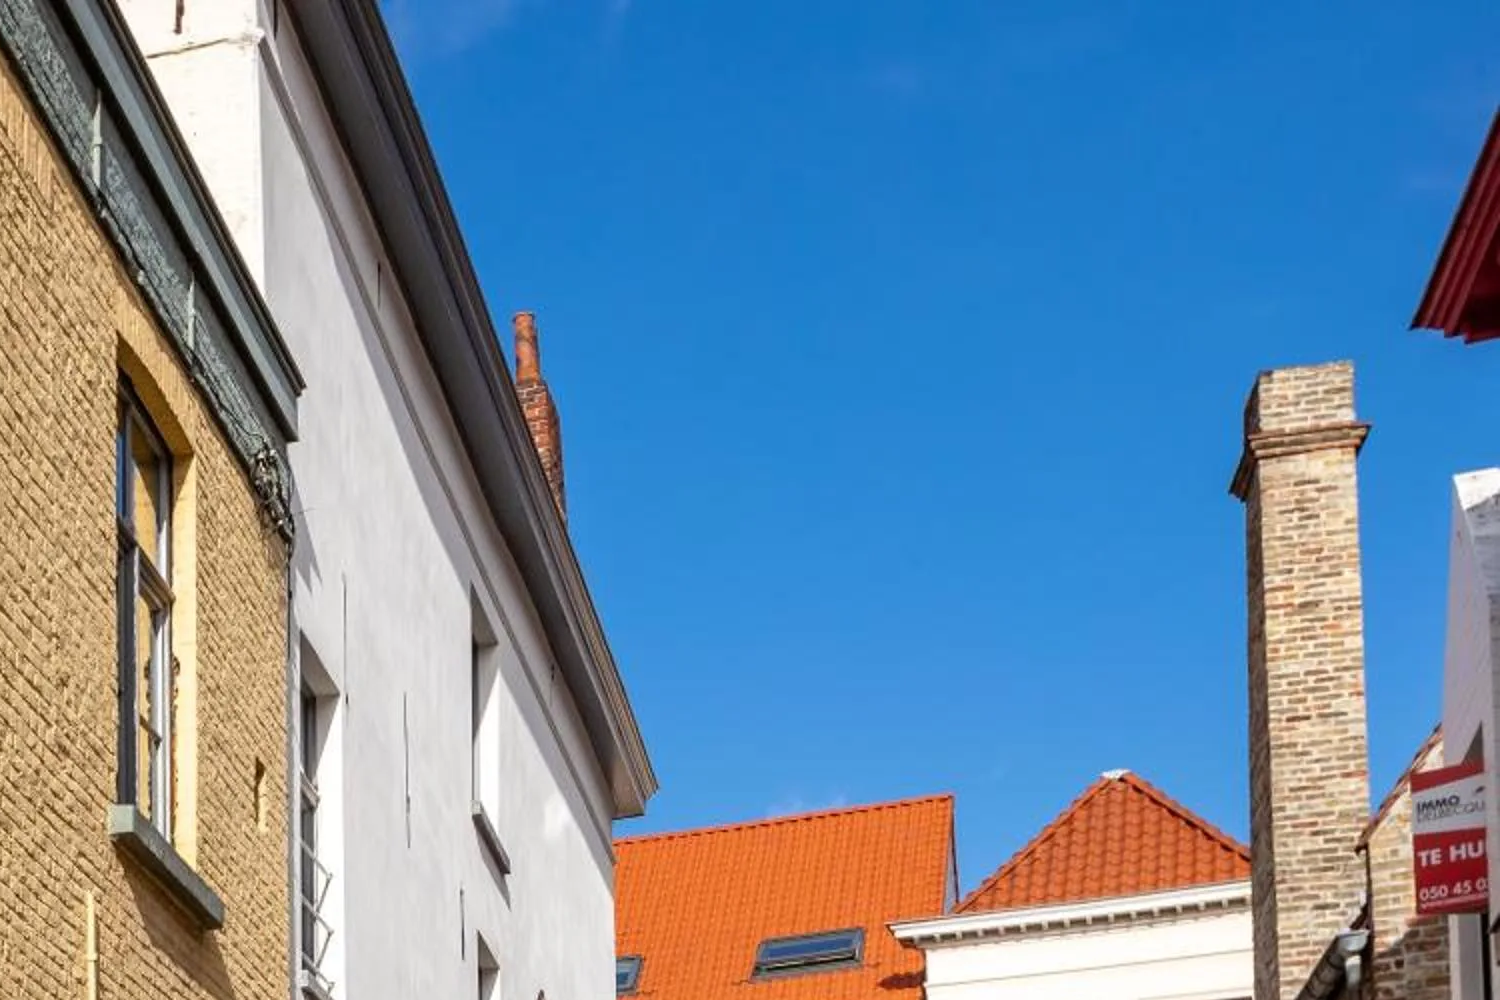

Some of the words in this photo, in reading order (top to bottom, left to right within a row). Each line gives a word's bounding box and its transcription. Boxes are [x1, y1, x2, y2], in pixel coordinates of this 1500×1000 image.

[1416, 795, 1460, 812] IMMO
[1417, 848, 1442, 868] TE
[1419, 884, 1449, 901] 050
[1453, 880, 1472, 895] 45
[1475, 876, 1488, 892] 0
